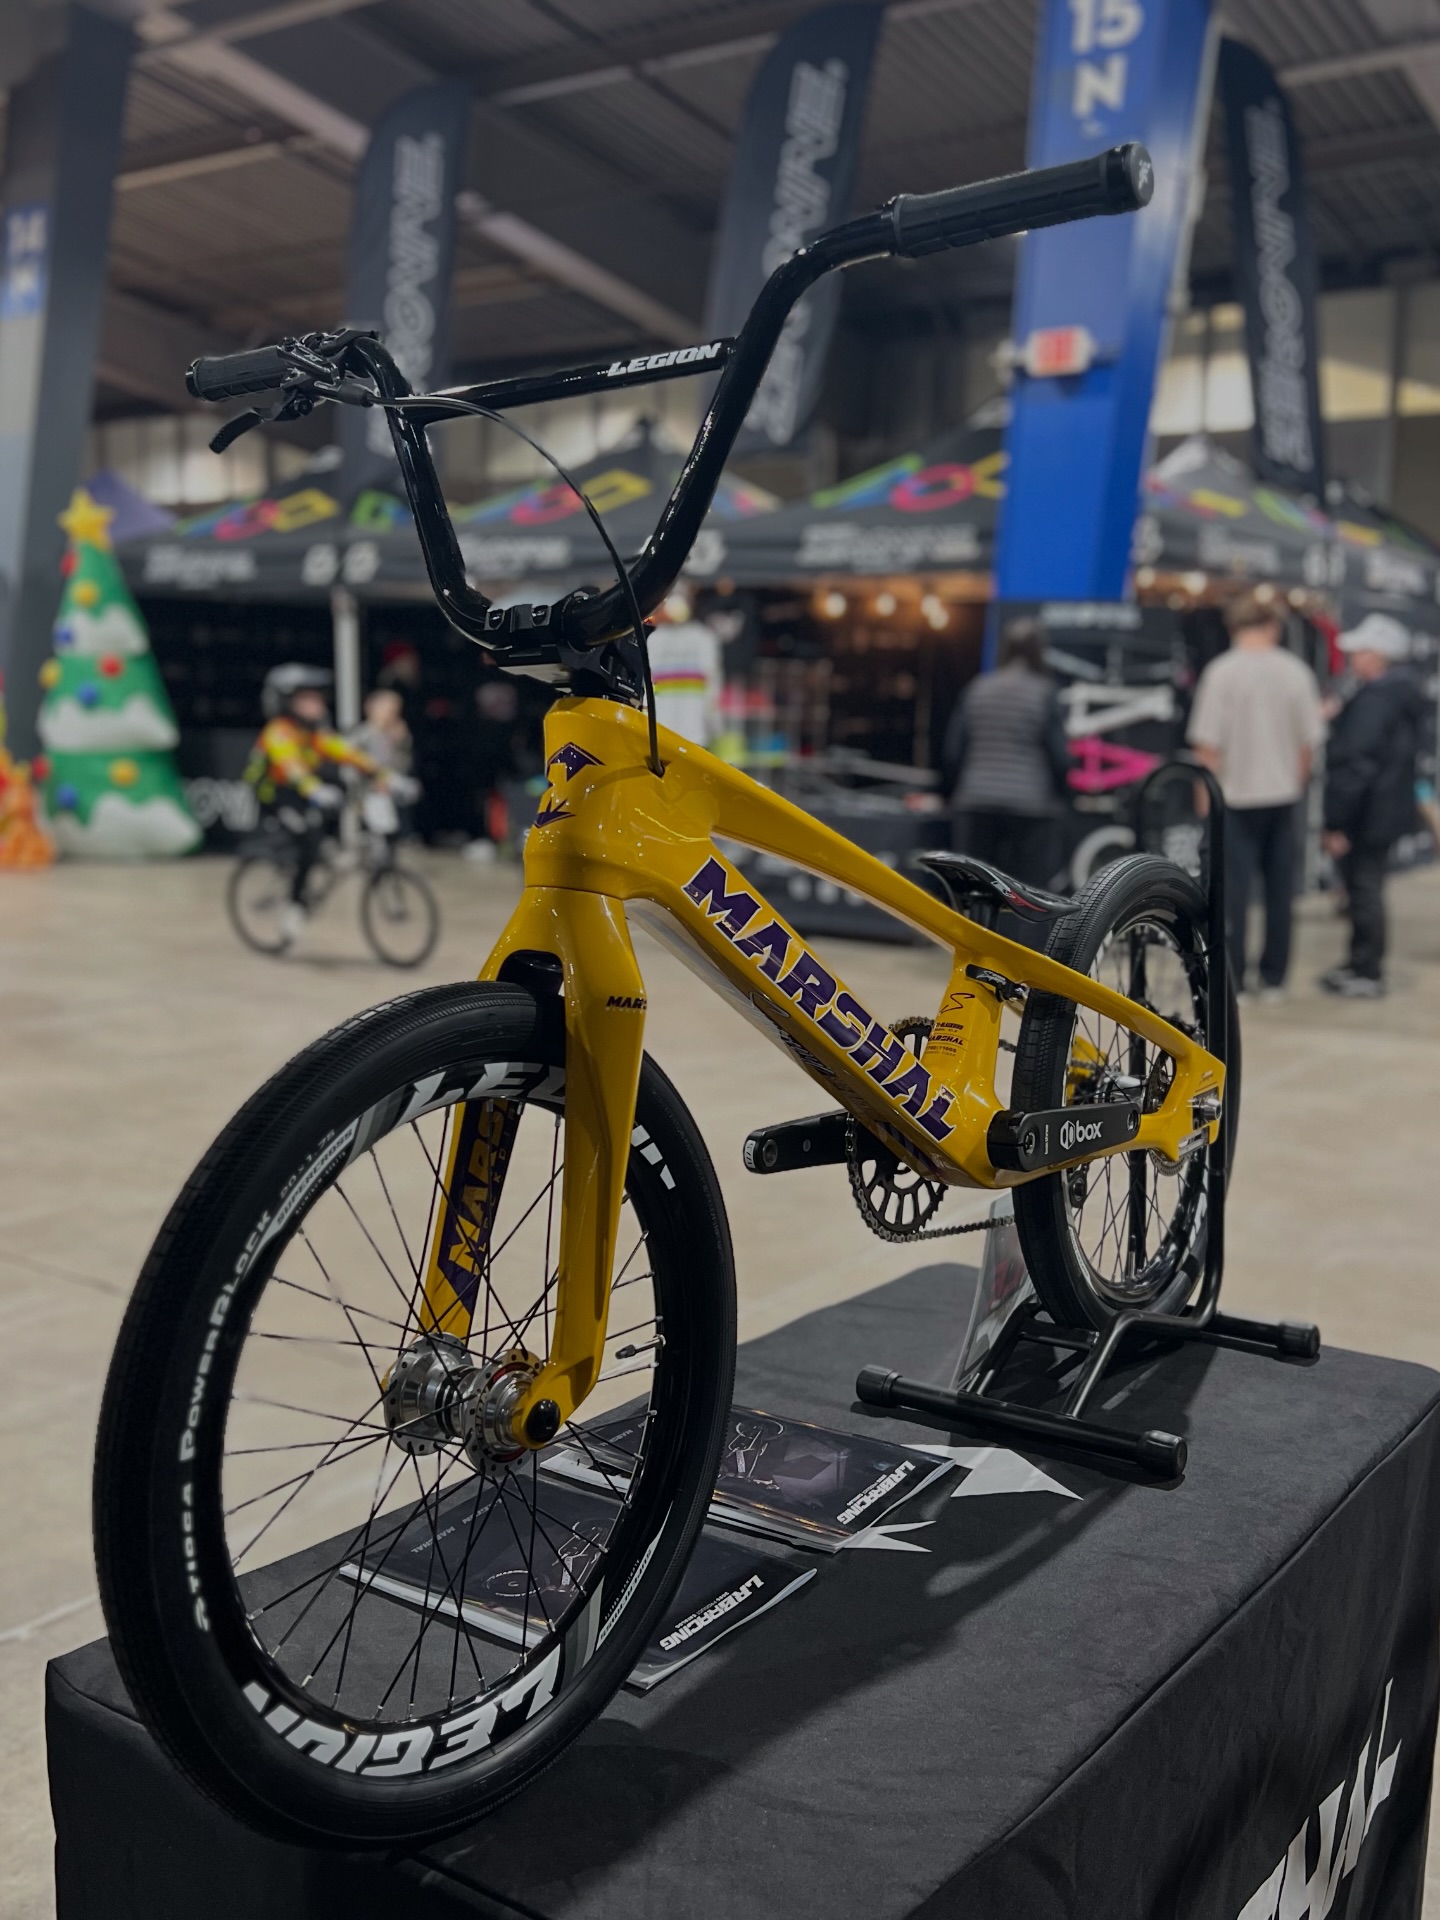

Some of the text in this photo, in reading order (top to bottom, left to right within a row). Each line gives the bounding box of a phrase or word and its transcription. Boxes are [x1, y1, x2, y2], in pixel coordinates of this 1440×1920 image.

[1071, 52, 1129, 119] N
[607, 342, 722, 377] LEGION
[680, 854, 957, 1142] MARSHAL
[1075, 1119, 1103, 1143] box
[276, 1127, 355, 1223] SUPERCROSS
[448, 1098, 510, 1276] MARS
